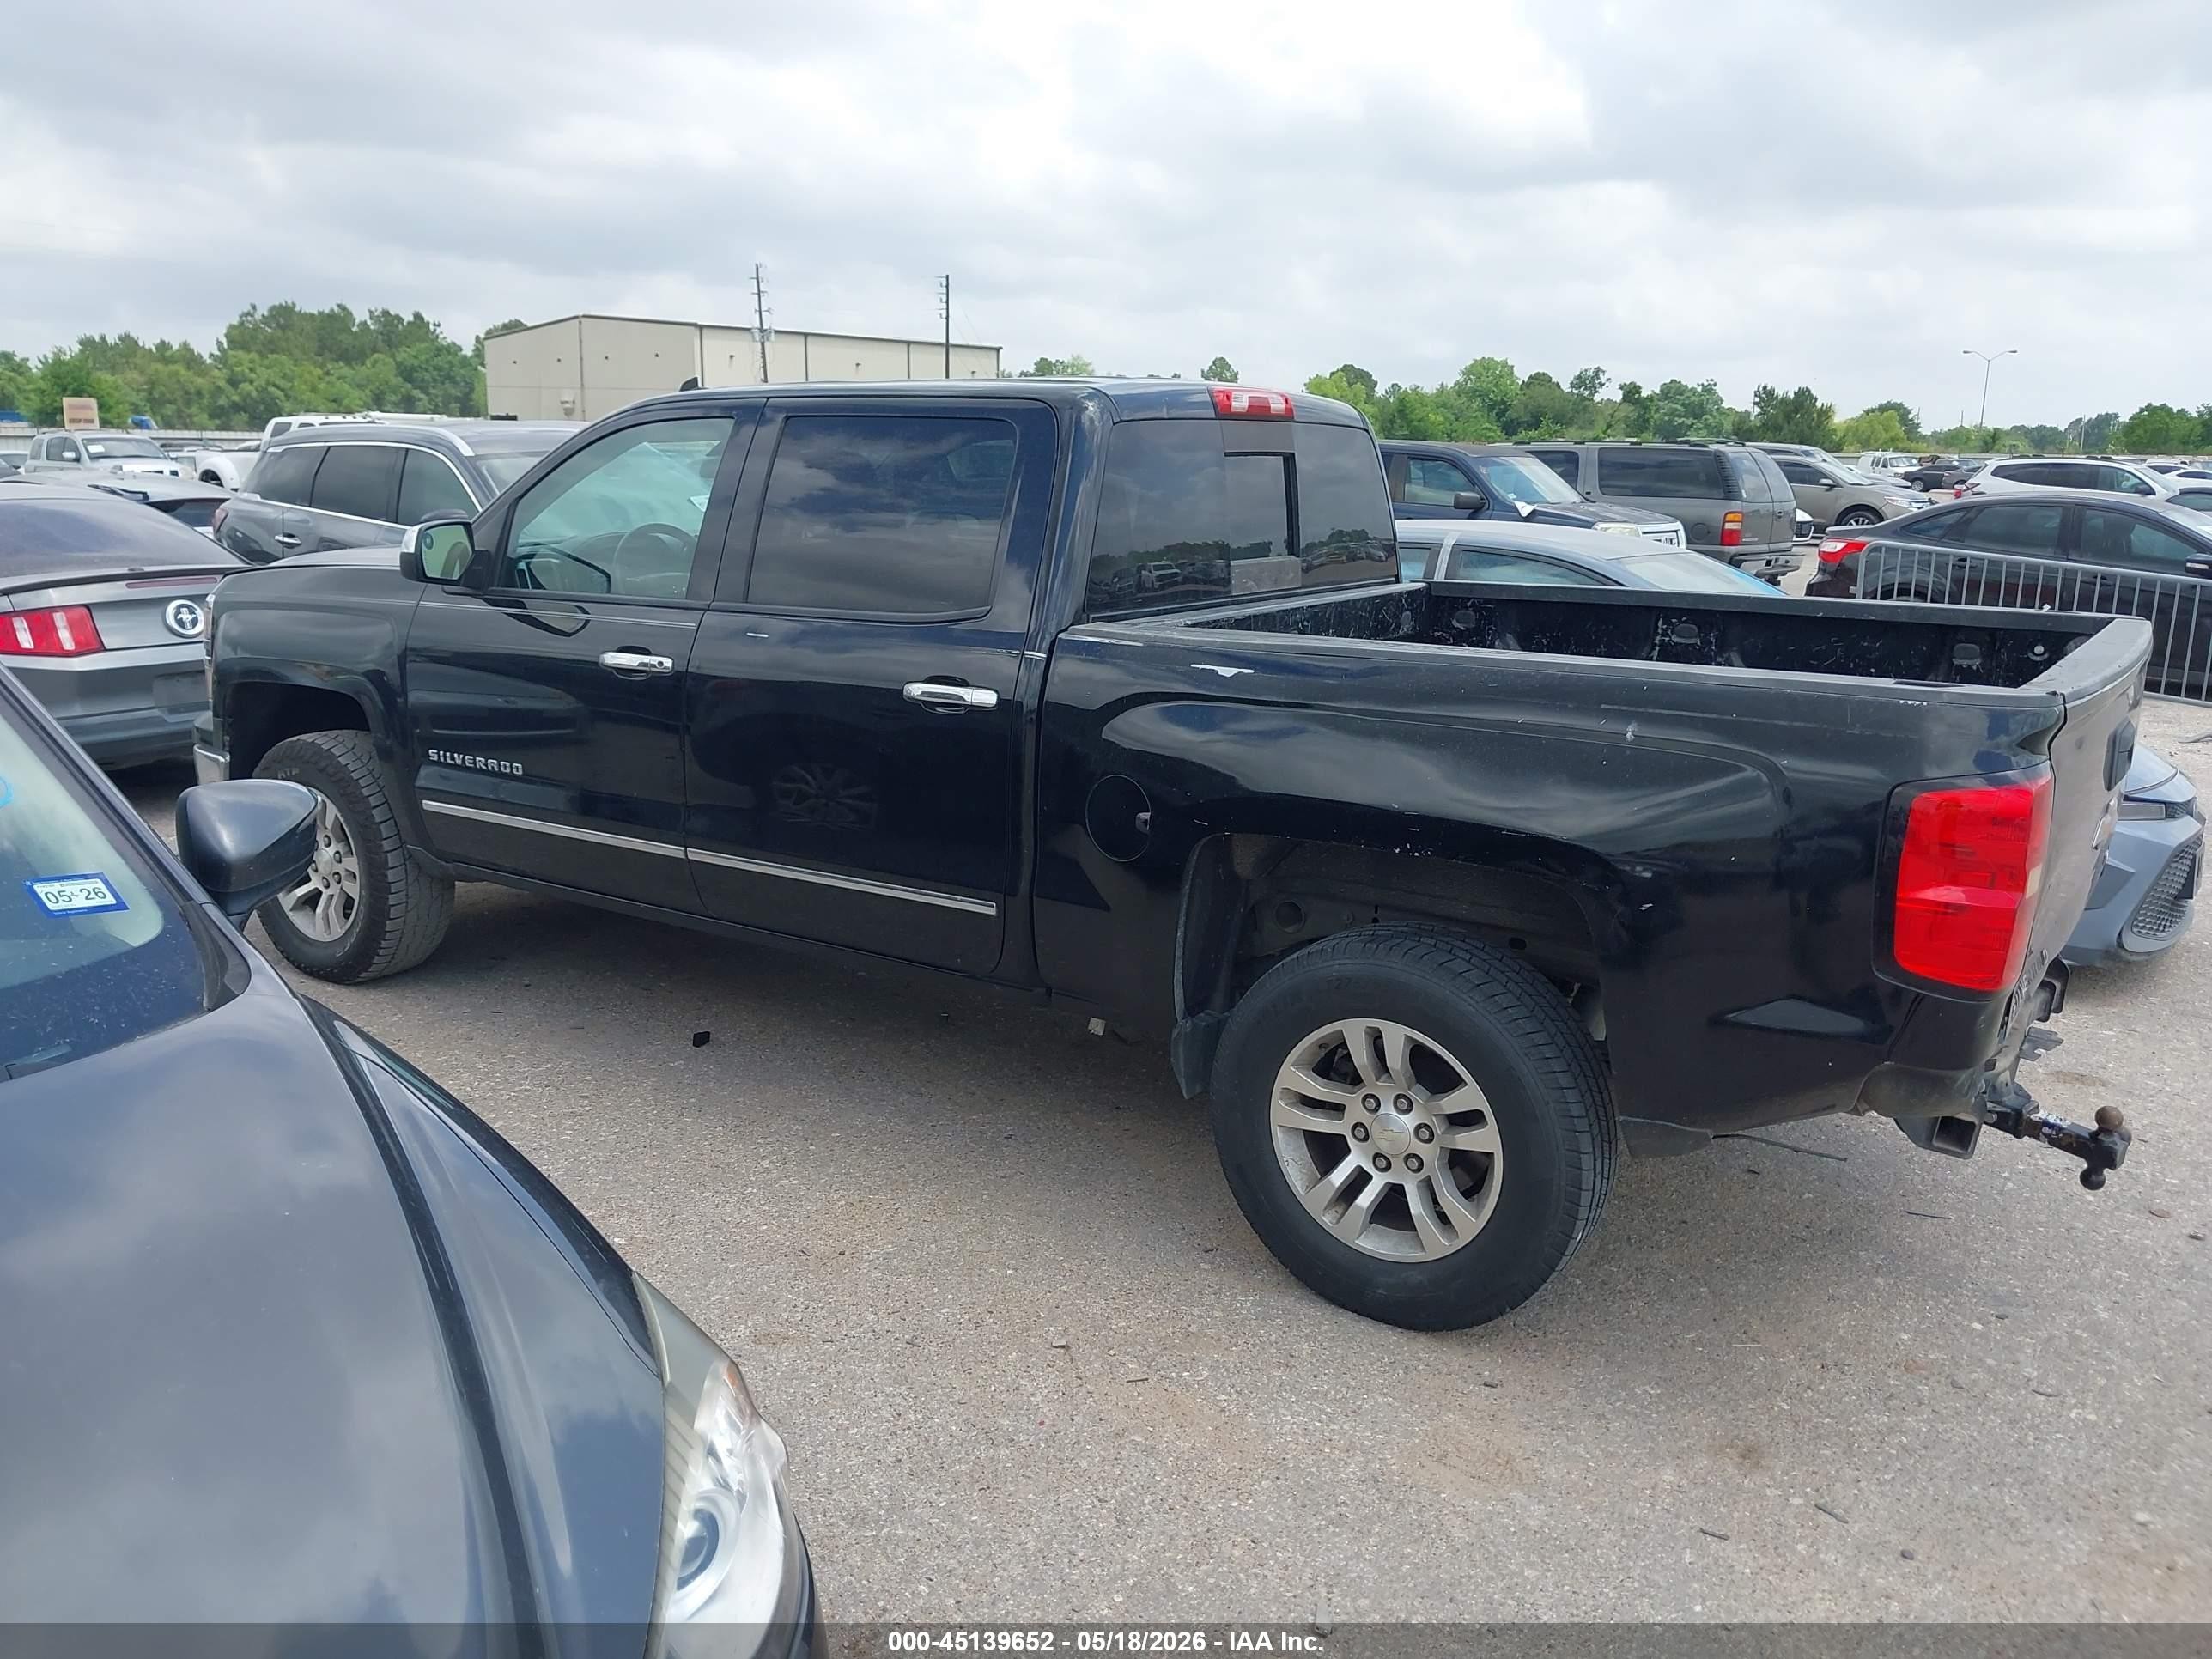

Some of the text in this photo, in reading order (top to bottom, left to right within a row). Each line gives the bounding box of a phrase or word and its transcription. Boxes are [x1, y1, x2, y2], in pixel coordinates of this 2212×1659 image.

[428, 749, 523, 775] SILVERADO
[44, 890, 72, 905] 05
[79, 886, 107, 901] 26
